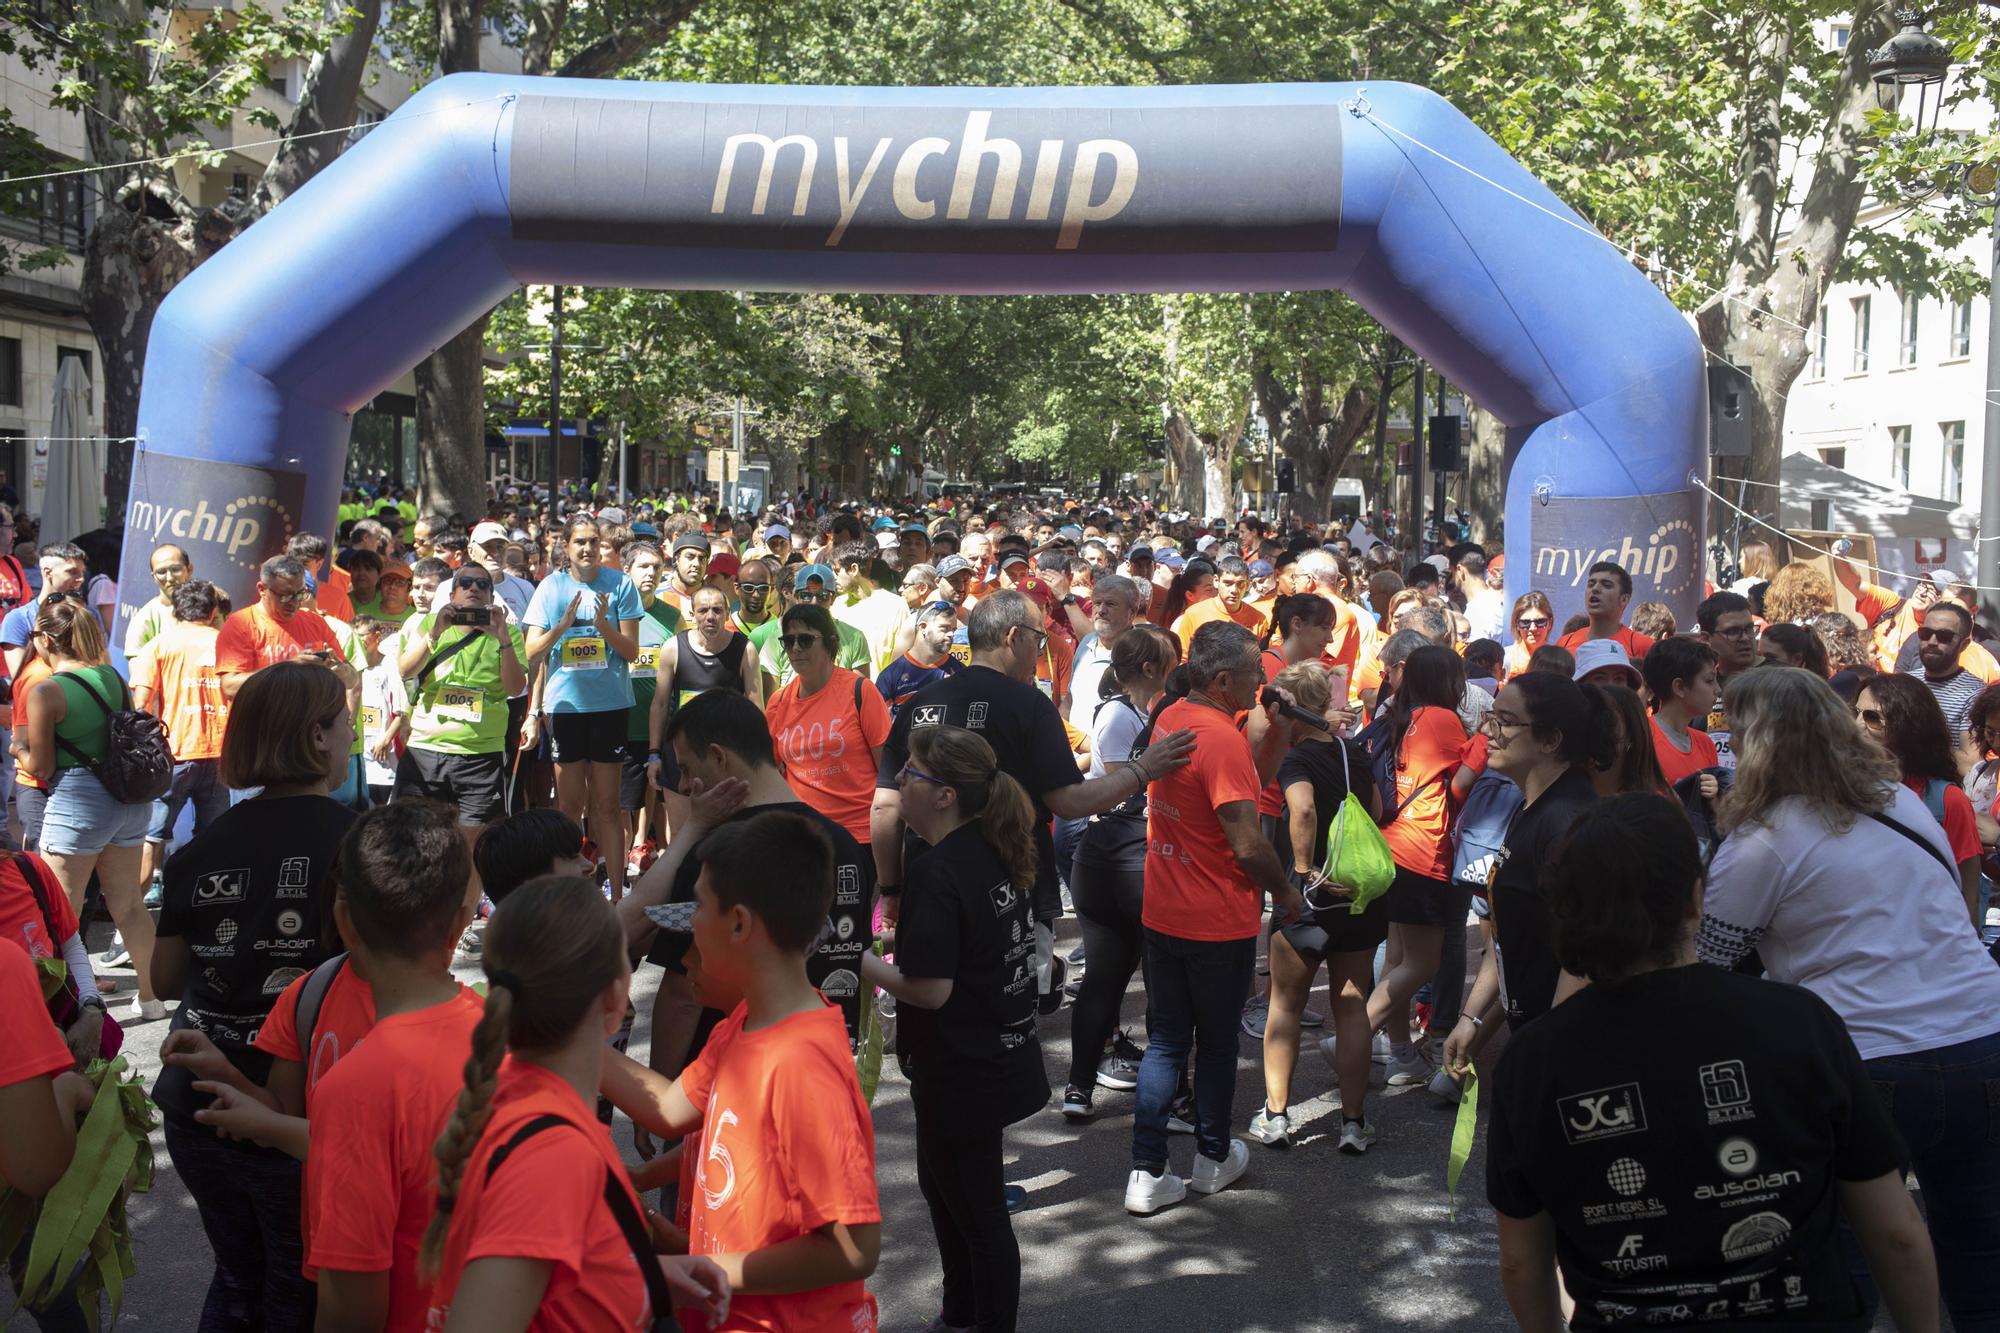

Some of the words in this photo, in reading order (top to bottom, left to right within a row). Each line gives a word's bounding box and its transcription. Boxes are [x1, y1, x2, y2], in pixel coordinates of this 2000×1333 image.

[711, 110, 1140, 250] mychip
[129, 498, 261, 555] mychip
[571, 645, 597, 657] 1005
[445, 694, 474, 706] 1005
[778, 718, 846, 763] 1005
[1707, 1104, 1753, 1119] STIL
[1693, 1170, 1802, 1200] ausolan
